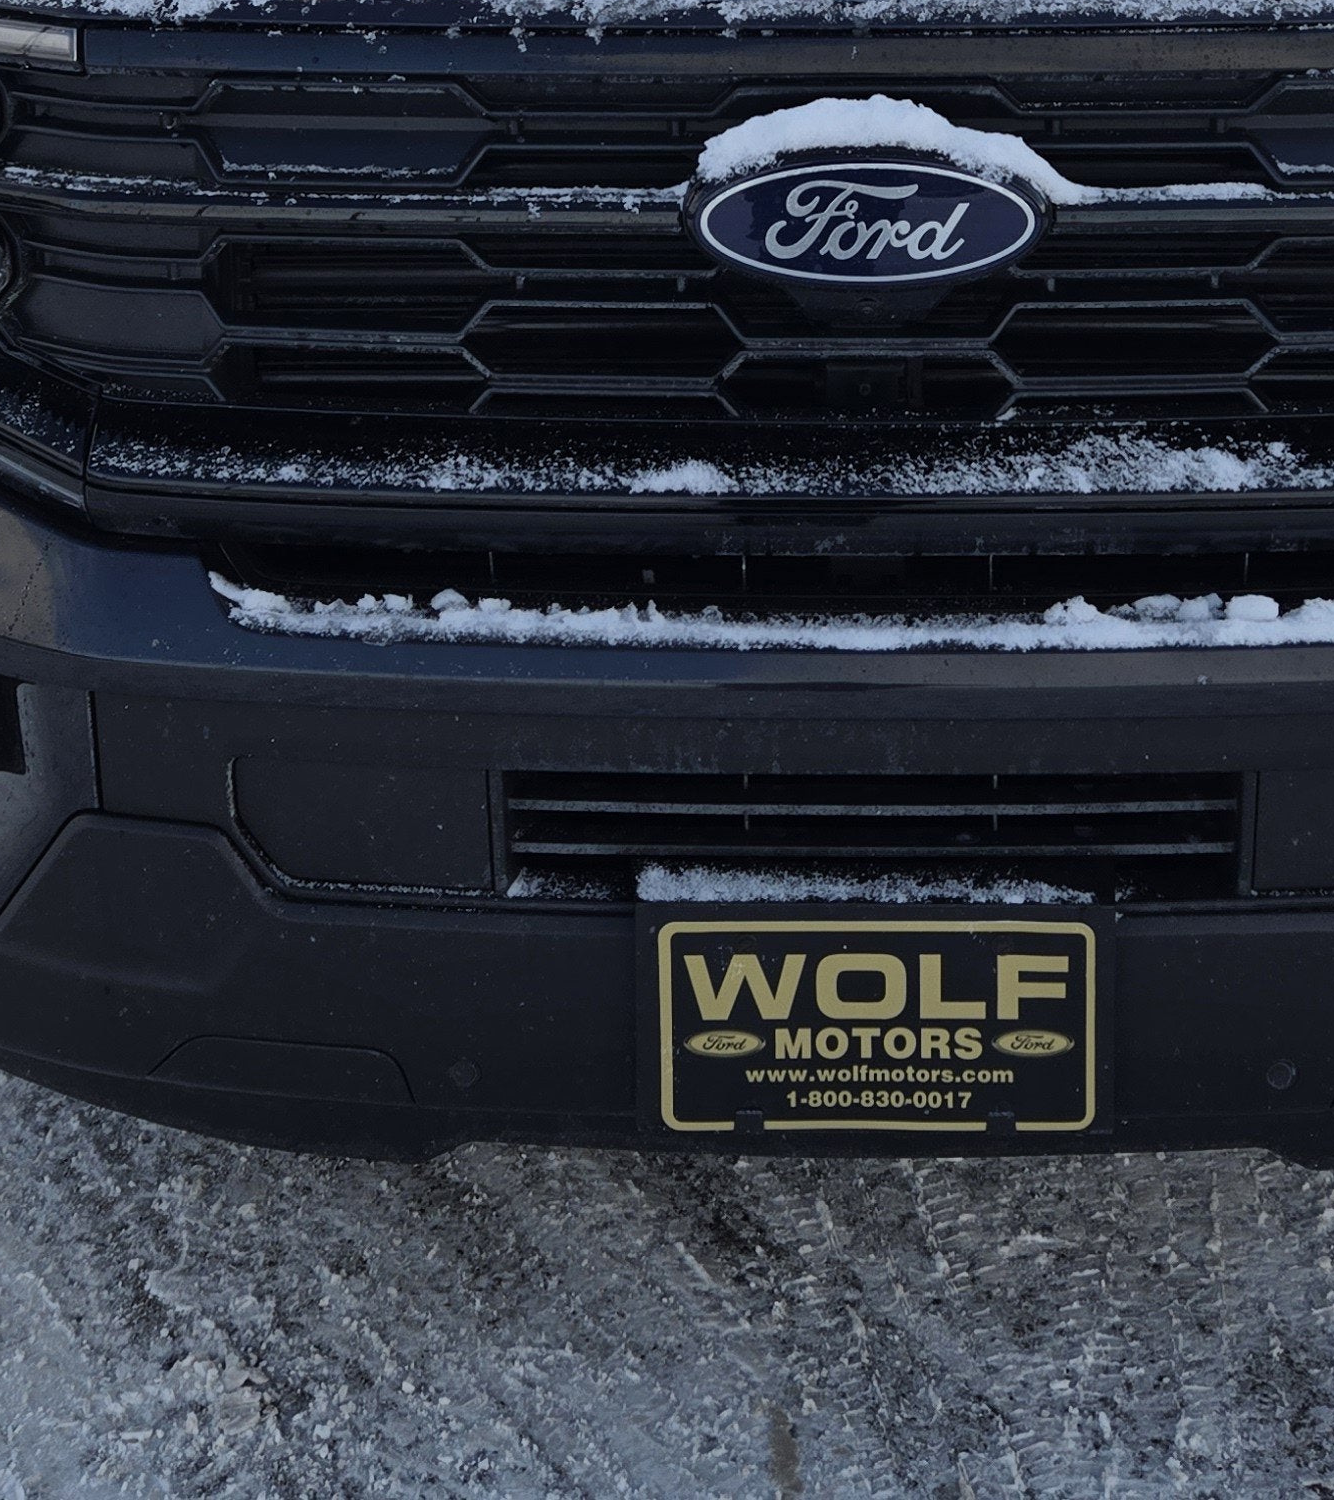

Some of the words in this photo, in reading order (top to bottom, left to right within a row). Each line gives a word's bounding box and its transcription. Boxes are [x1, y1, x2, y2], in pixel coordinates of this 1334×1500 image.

[764, 180, 971, 260] Ford
[683, 953, 1070, 1021] WOLF
[701, 1033, 748, 1053] Ford
[774, 1027, 983, 1061] MOTORS
[1009, 1033, 1056, 1053] Ford
[745, 1065, 1014, 1085] www.wolfmotors.com
[786, 1090, 973, 1109] 1-800-830-0017
